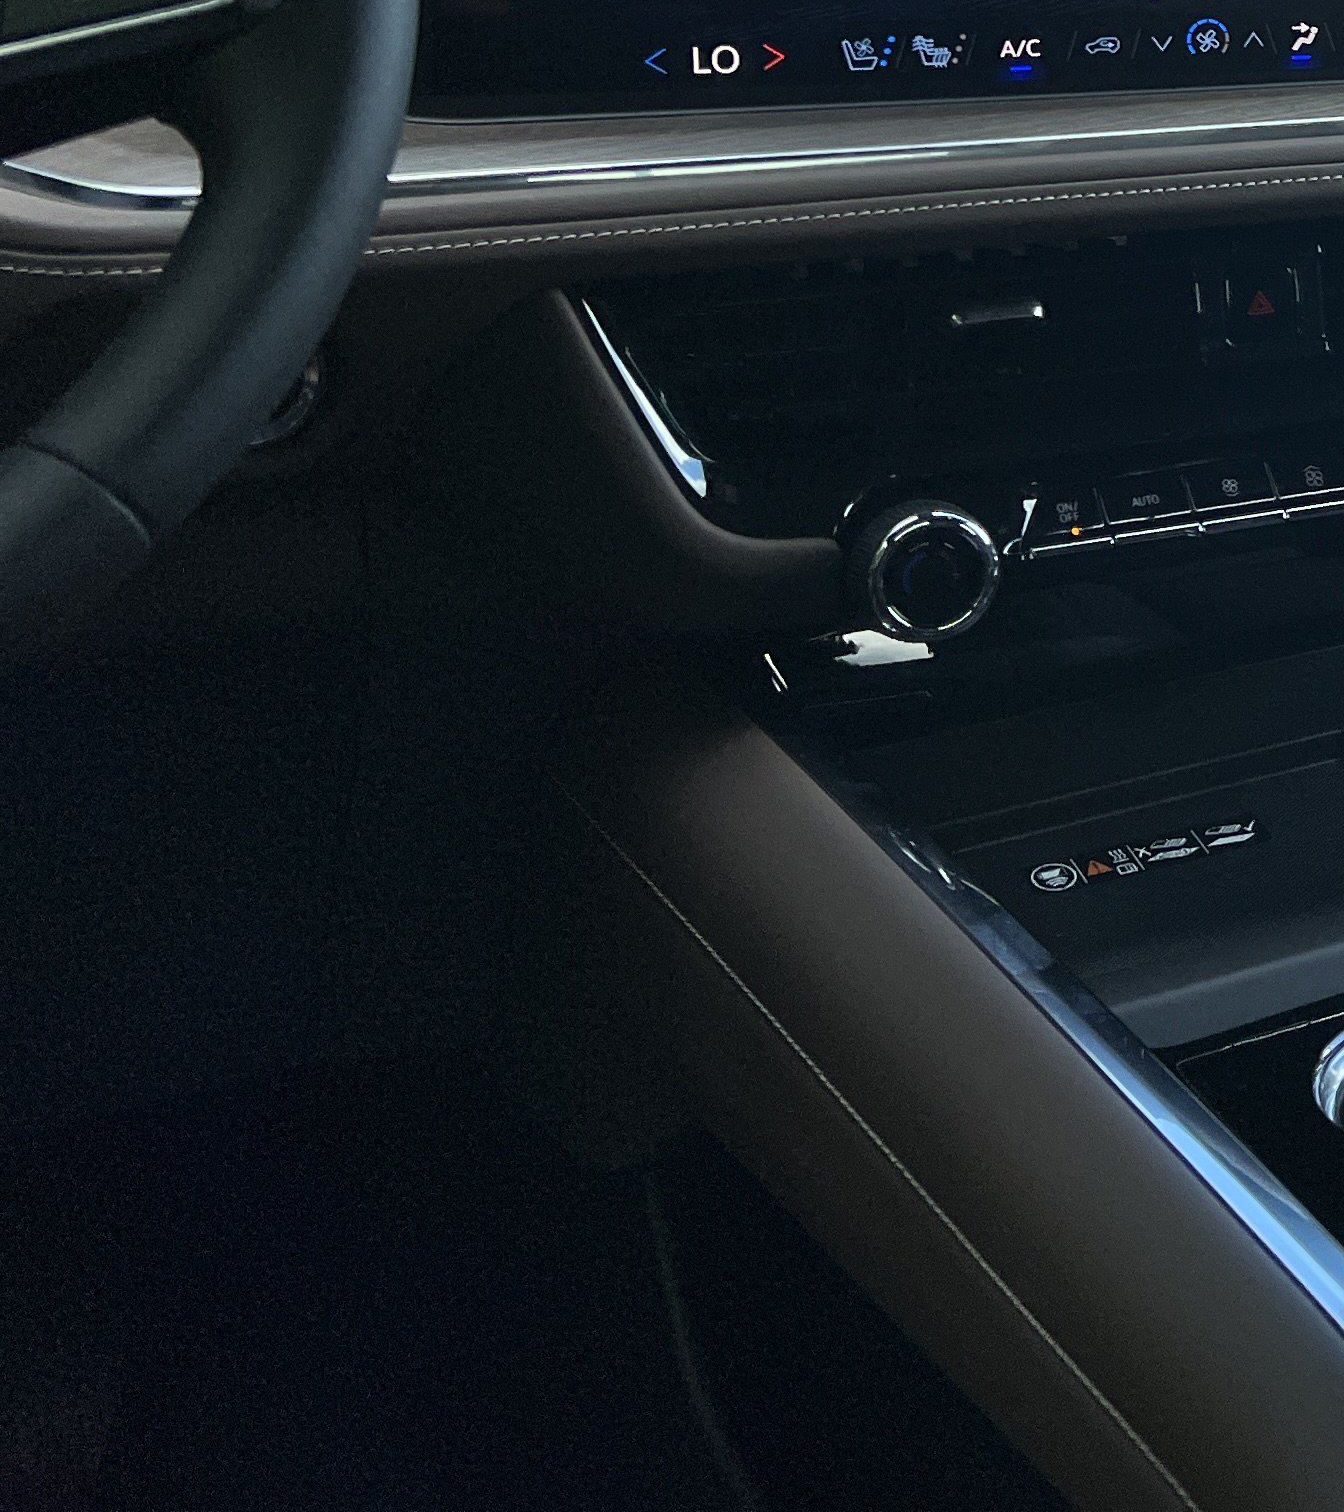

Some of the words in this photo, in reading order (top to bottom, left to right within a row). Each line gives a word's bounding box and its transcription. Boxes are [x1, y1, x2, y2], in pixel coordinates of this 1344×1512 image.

[1000, 38, 1041, 58] A/C
[692, 44, 741, 75] LO
[1056, 501, 1079, 513] ON/
[1131, 494, 1160, 507] AUTO
[1060, 512, 1080, 524] OFF
